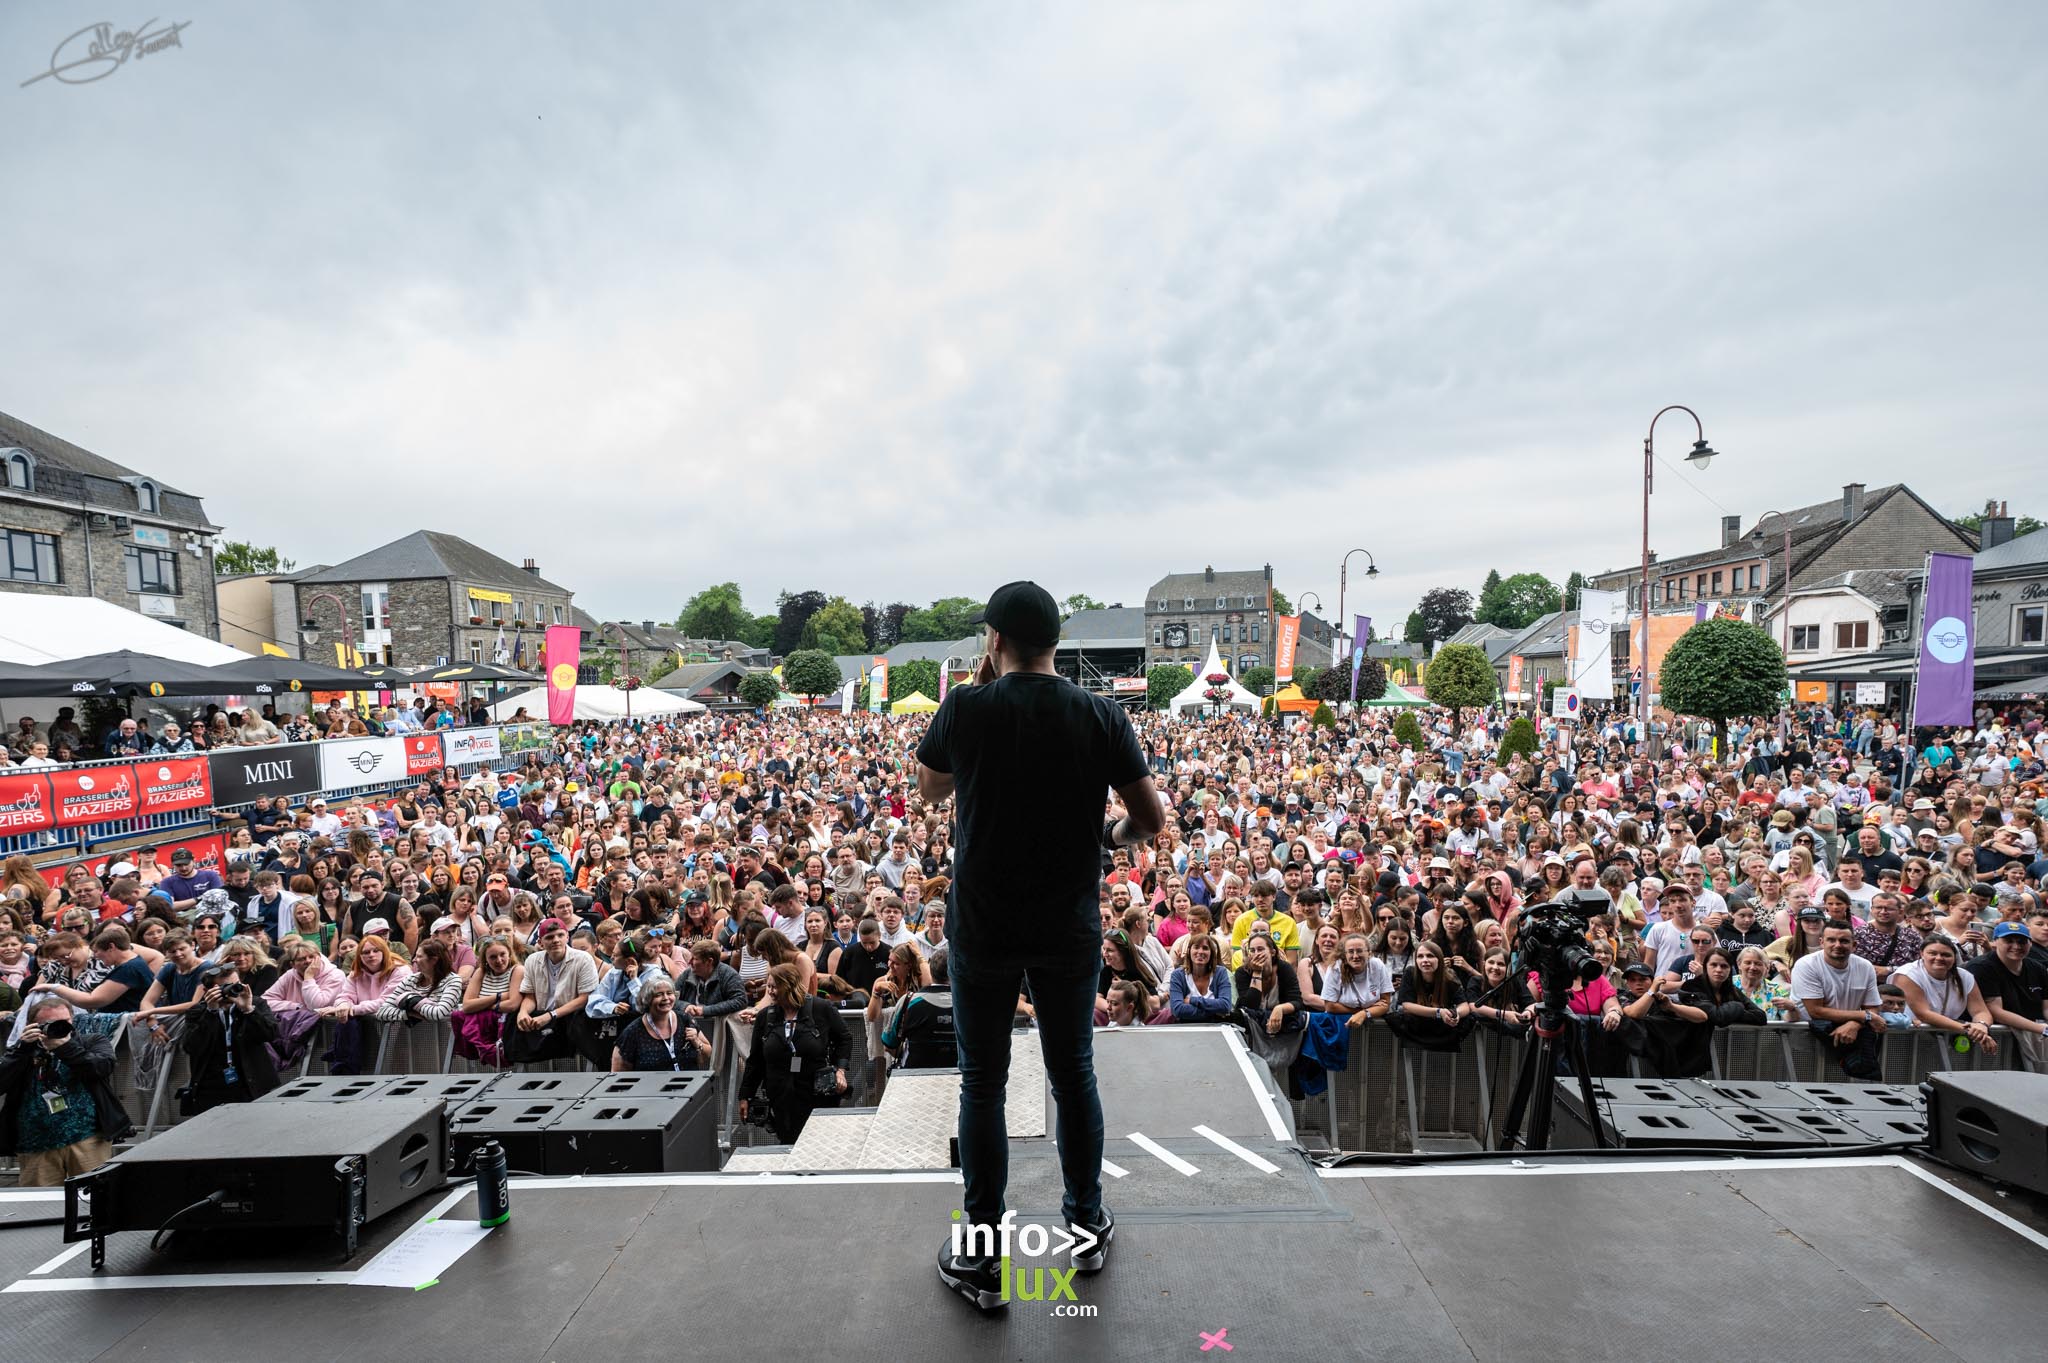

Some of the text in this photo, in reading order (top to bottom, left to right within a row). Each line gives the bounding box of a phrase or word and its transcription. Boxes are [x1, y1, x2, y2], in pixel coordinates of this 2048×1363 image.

[360, 758, 373, 766] MINI
[243, 760, 294, 785] MINI
[64, 792, 110, 804] BRASSERIE
[147, 788, 206, 806] MAZIERS
[64, 799, 132, 819] MAZIERS
